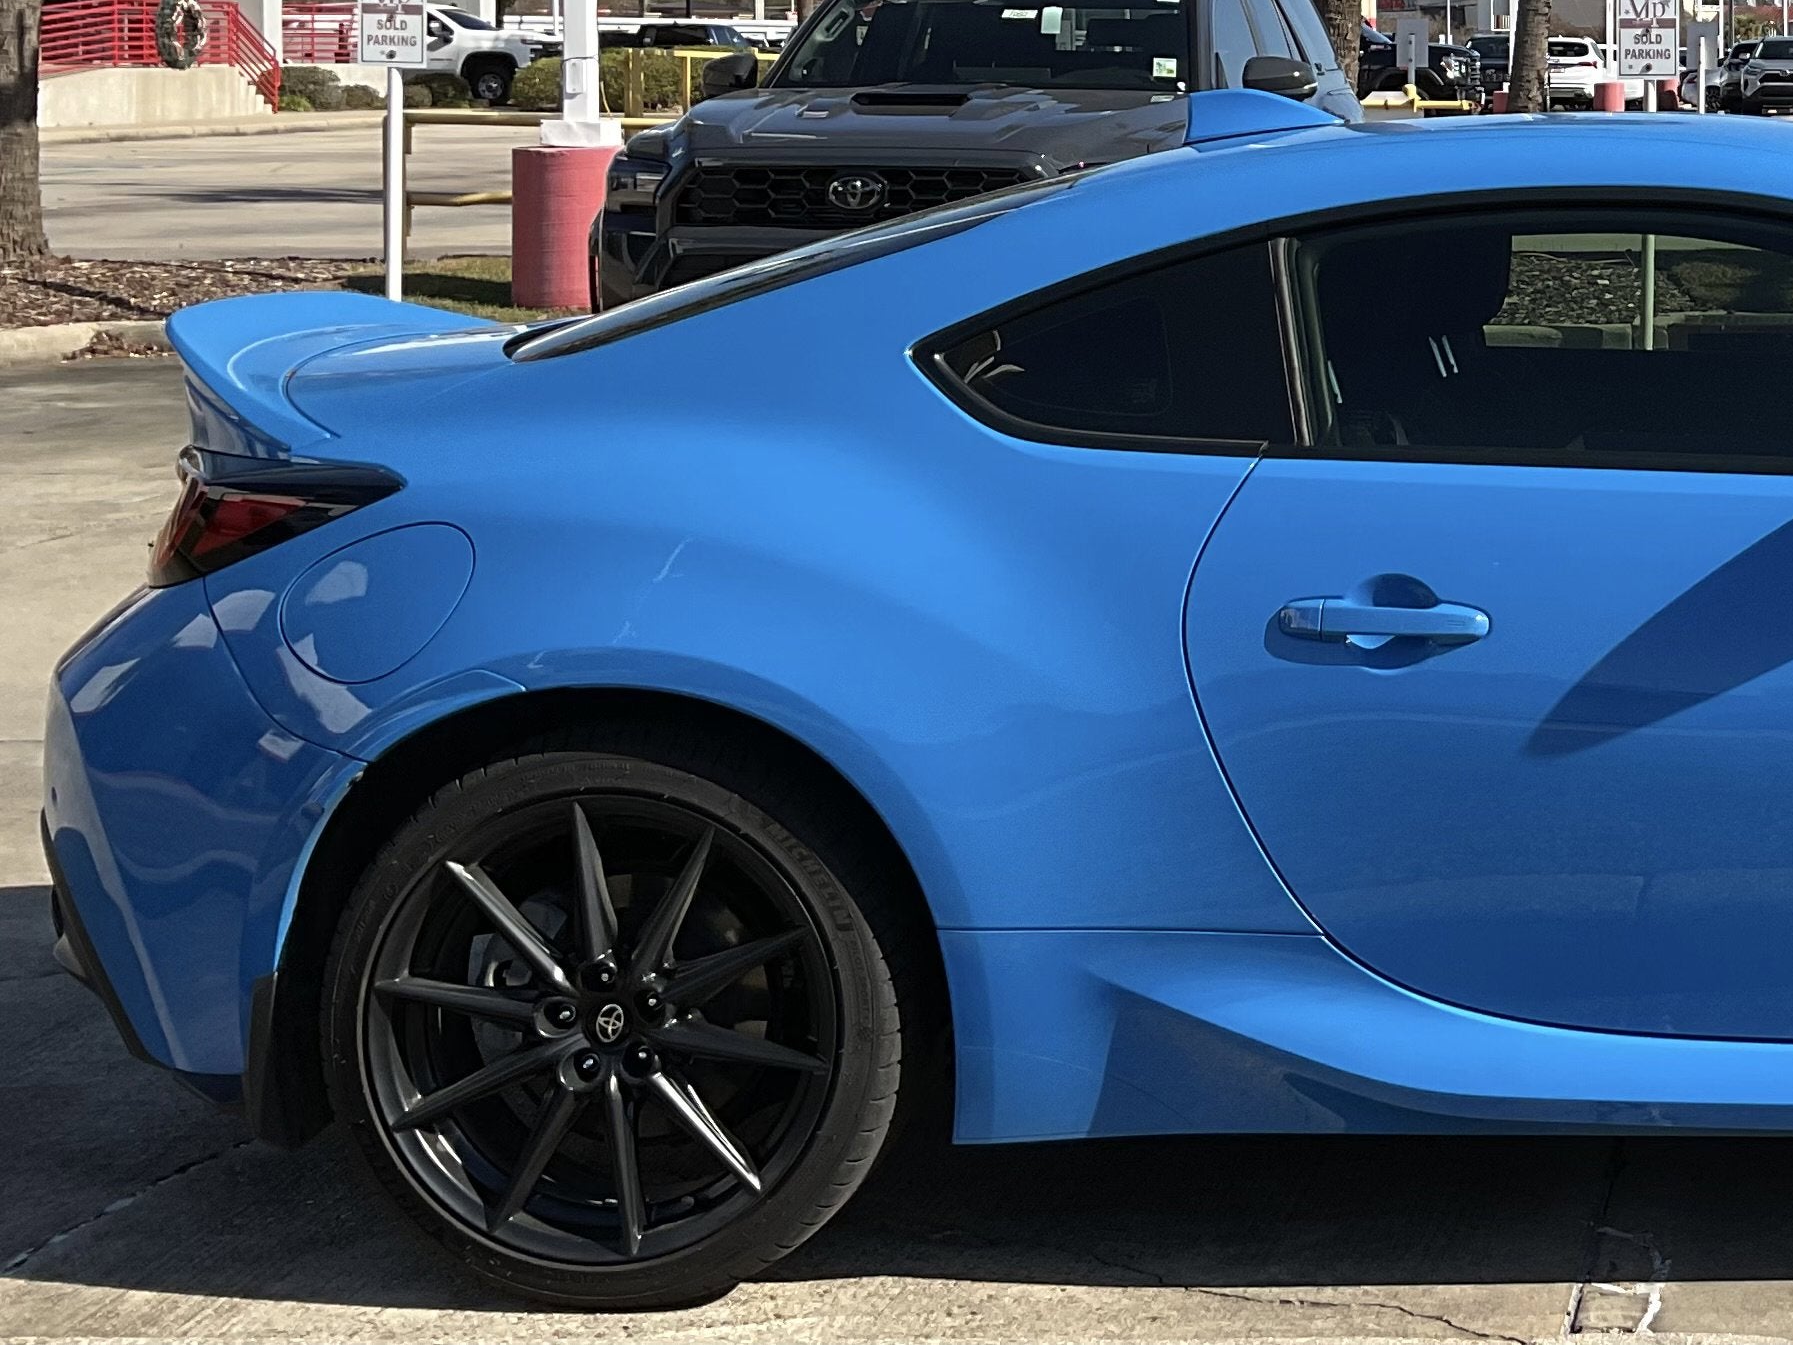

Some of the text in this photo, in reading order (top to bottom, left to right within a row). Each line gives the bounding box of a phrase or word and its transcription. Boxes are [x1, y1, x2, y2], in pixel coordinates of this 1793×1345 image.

[376, 18, 408, 31] SOLD
[366, 34, 417, 47] PARKING
[1634, 34, 1662, 45] SOLD
[1624, 48, 1671, 60] PARKING
[764, 820, 855, 931] MICHELIN
